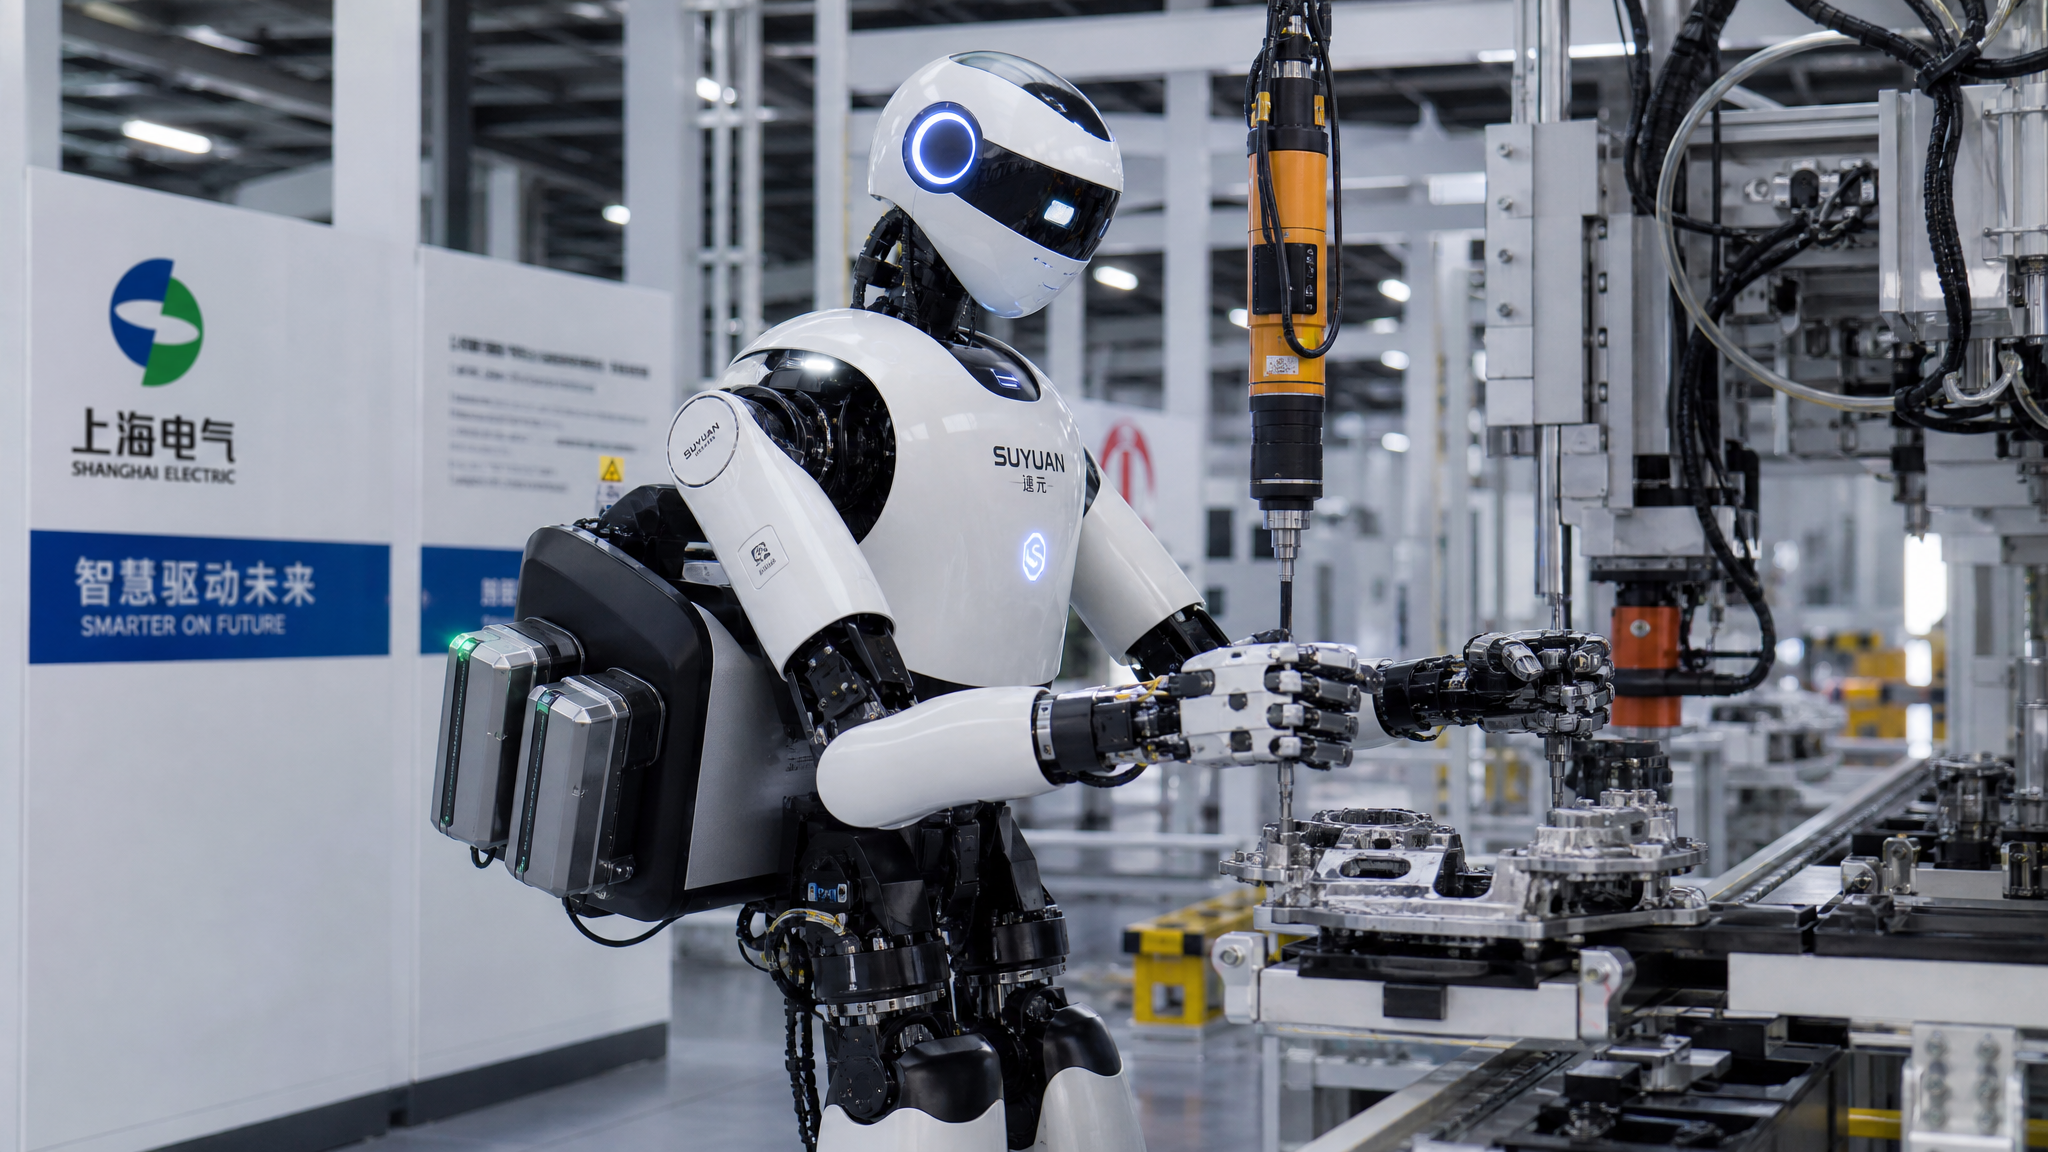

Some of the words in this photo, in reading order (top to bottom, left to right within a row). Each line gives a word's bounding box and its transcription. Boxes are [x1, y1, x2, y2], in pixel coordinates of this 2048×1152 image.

[71, 406, 235, 464] 上海电气
[683, 421, 720, 460] SUYUAN
[71, 460, 159, 480] SHANGHAI
[164, 465, 236, 485] ELECTRIC
[993, 445, 1065, 473] SUYUAN
[75, 556, 316, 608] 智慧驱动未来
[80, 614, 177, 637] SMARTER
[181, 614, 212, 636] ON
[216, 613, 287, 635] FUTURE
